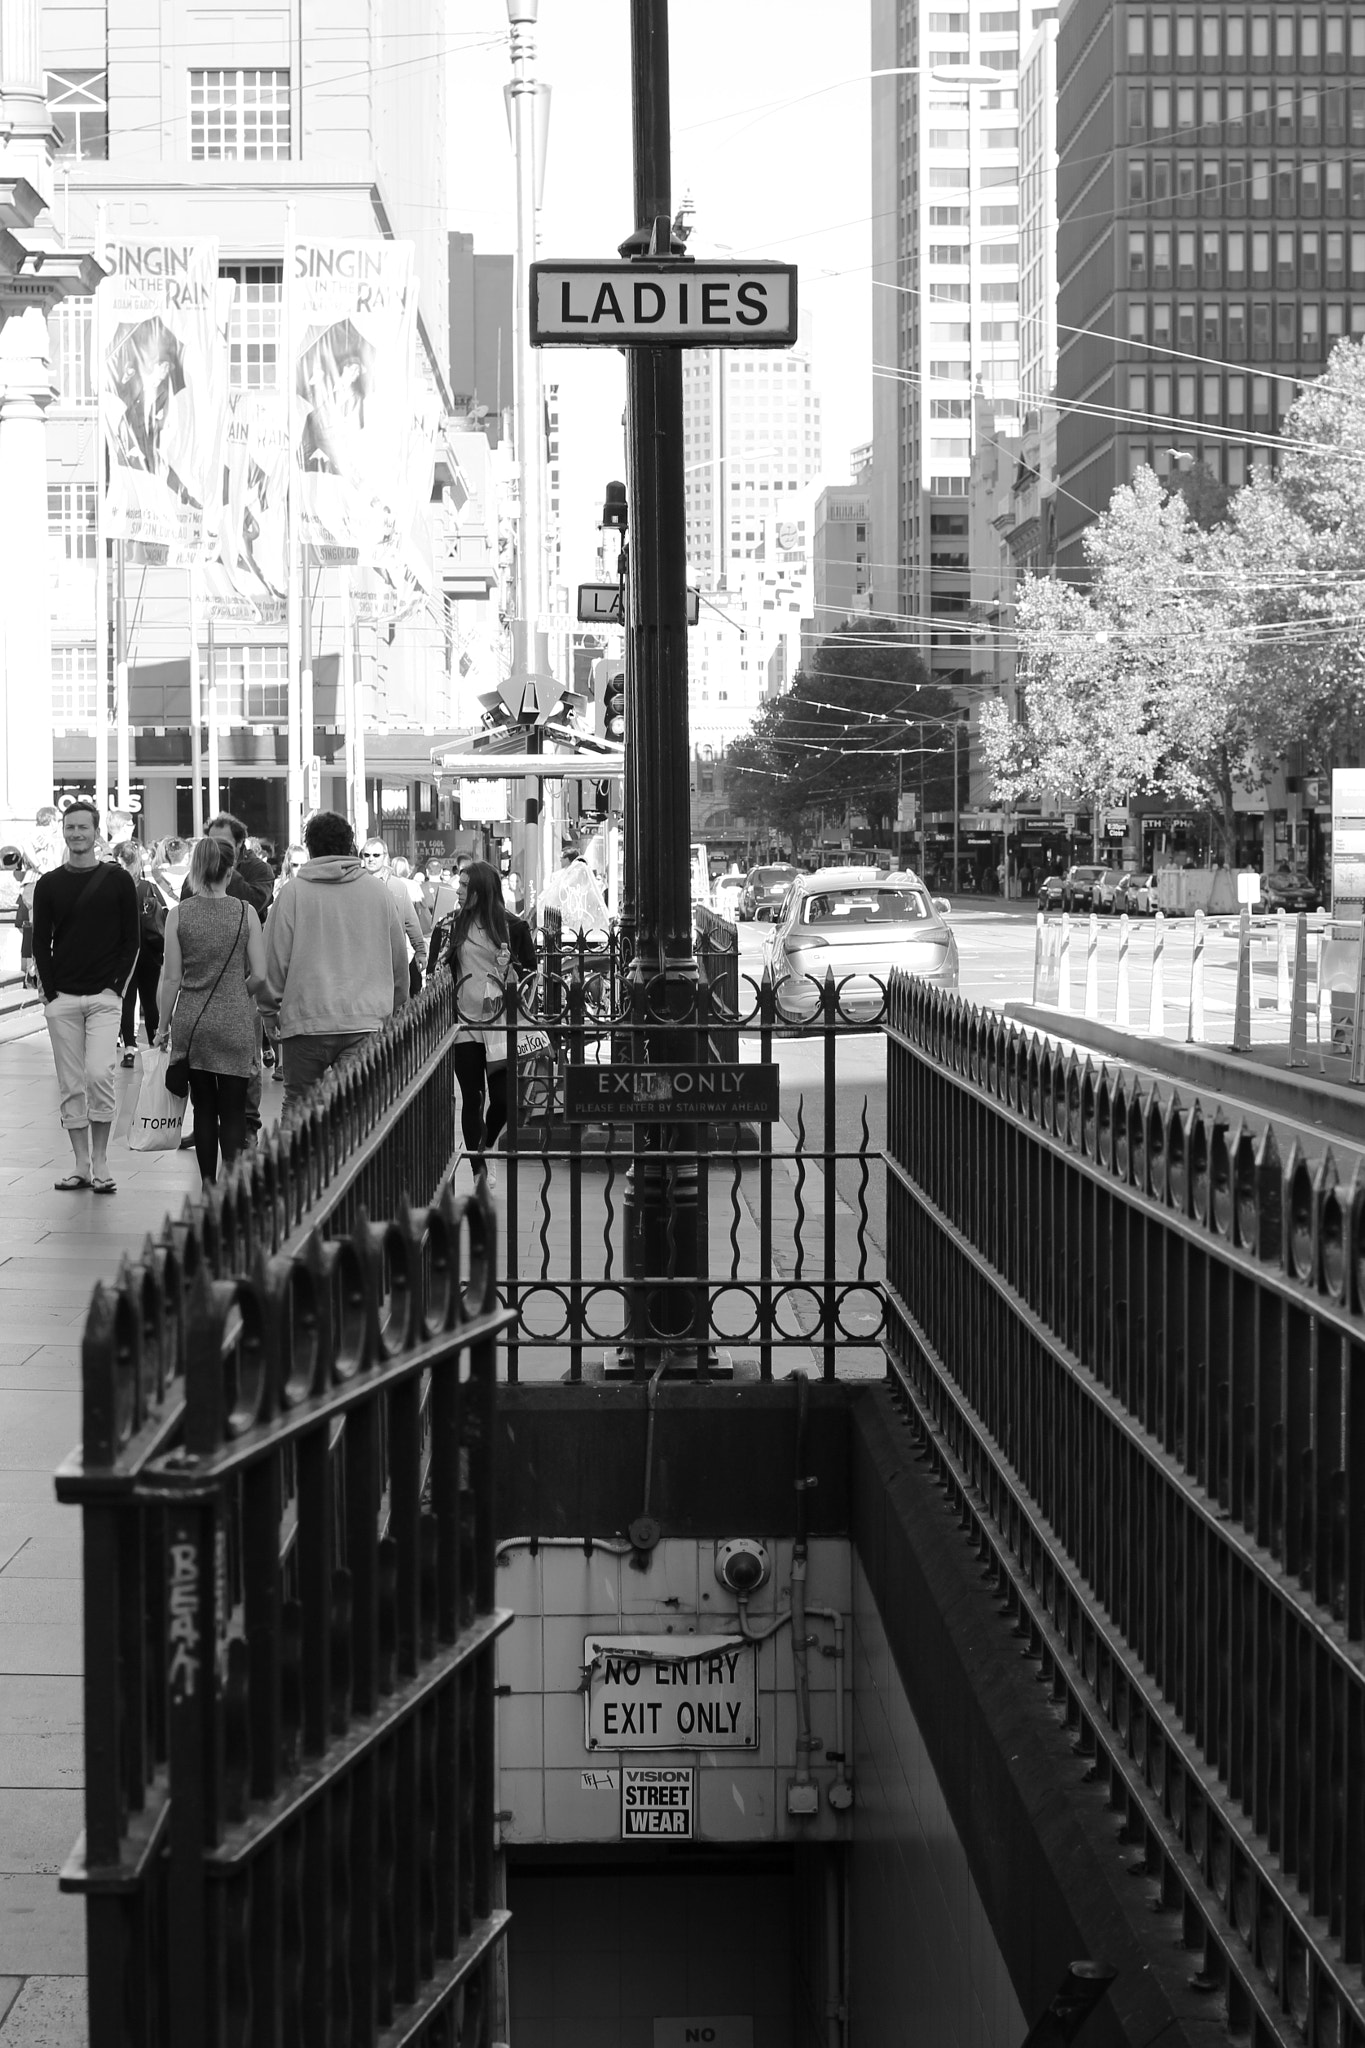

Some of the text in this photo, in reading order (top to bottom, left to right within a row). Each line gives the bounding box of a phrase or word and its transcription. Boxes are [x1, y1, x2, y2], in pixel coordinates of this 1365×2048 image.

[105, 242, 194, 277] SINGIN'
[295, 244, 388, 279] SINGIN'
[125, 278, 213, 310] IN THE RAIN
[315, 280, 327, 293] IN
[561, 281, 768, 325] LADIES
[599, 1072, 745, 1093] EXIT ONLY
[575, 1102, 768, 1113] PLEASE ENTER BY STAIRWAY AHEAD
[604, 1653, 740, 1686] NO ENTRY
[604, 1701, 741, 1734] EXIT ONLY
[626, 1771, 690, 1782] VISION
[626, 1785, 690, 1806] STREET
[630, 1811, 685, 1832] WEAR
[685, 2027, 716, 2043] NO
